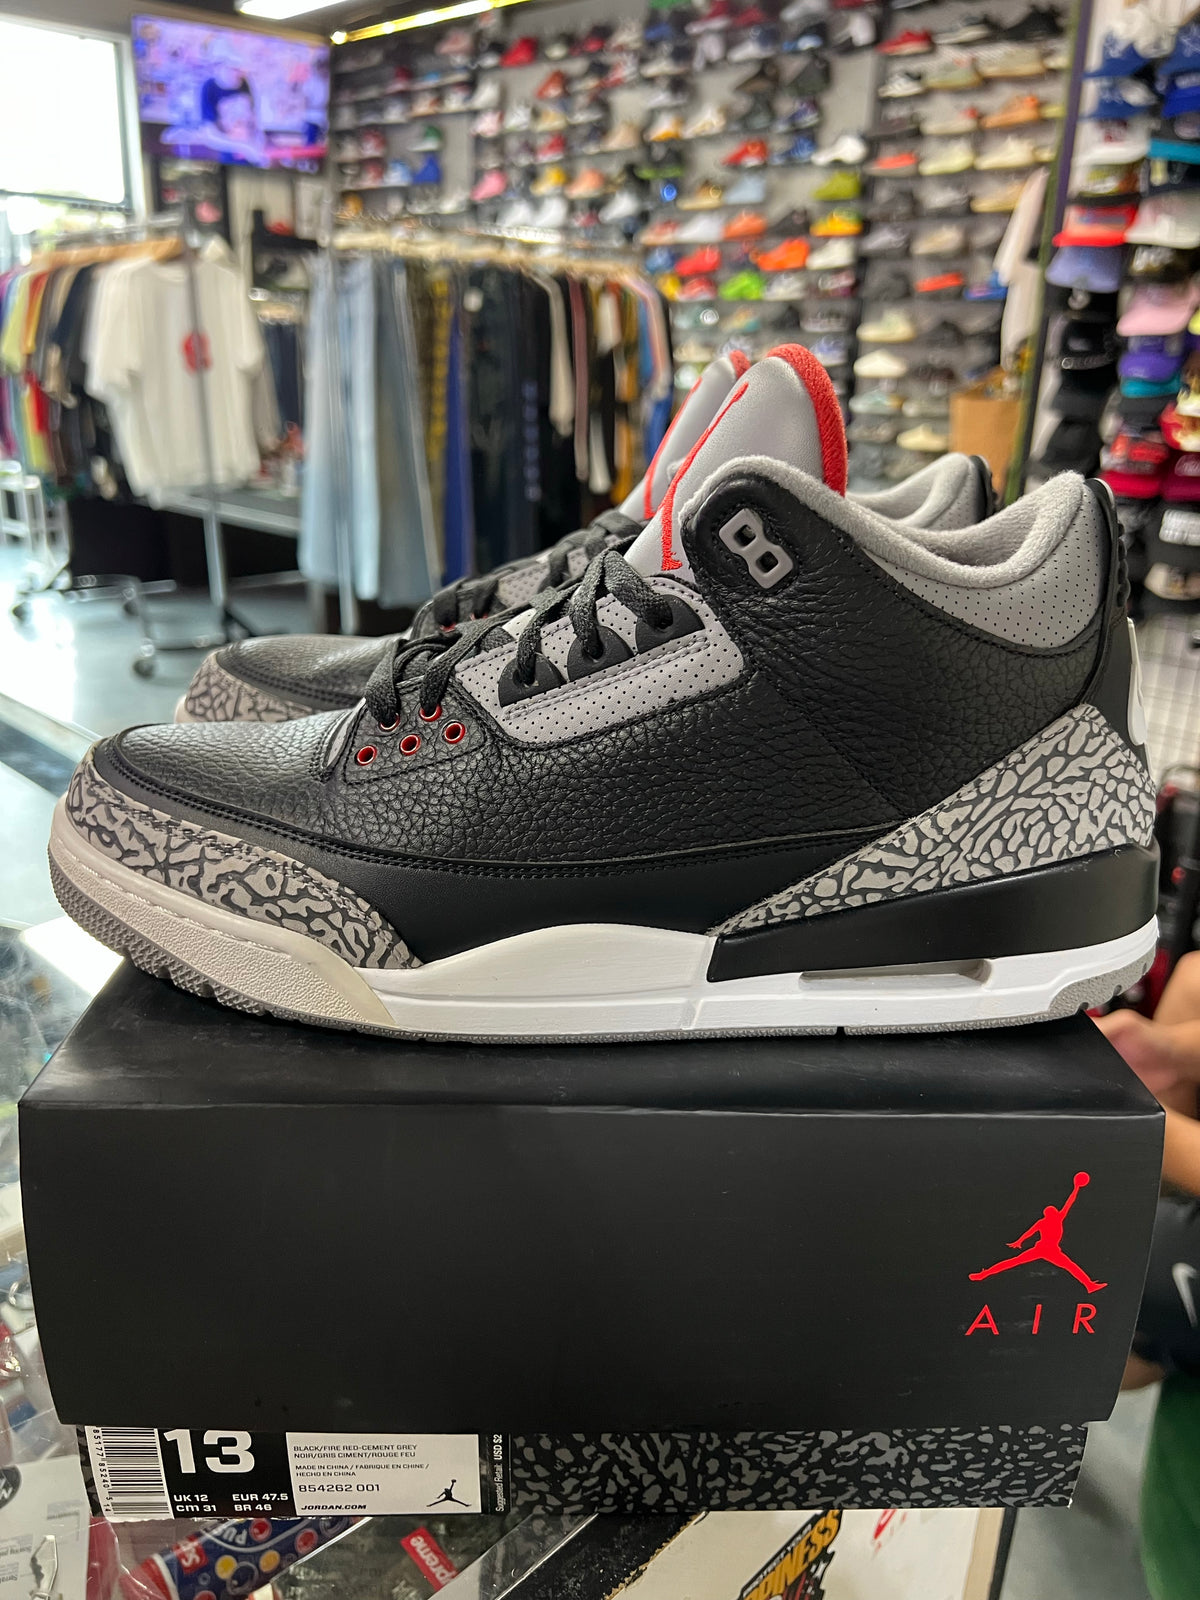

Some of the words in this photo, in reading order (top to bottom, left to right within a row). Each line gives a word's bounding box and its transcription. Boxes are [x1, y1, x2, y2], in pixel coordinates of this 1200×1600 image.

[965, 1303, 1097, 1336] AIR
[163, 1428, 255, 1474] 13
[337, 1451, 399, 1459] CIMENT/ROUGE
[493, 1444, 503, 1460] USD
[98, 1462, 110, 1489] 85240
[298, 1484, 353, 1493] 854262
[356, 1483, 380, 1492] 001
[173, 1494, 192, 1502] UK
[194, 1494, 209, 1502] 12
[232, 1493, 259, 1501] EUR
[261, 1493, 289, 1501] 47.5
[495, 1483, 506, 1512] Suggested
[202, 1504, 217, 1512] 31
[234, 1504, 252, 1512] BR
[255, 1503, 272, 1511] 46
